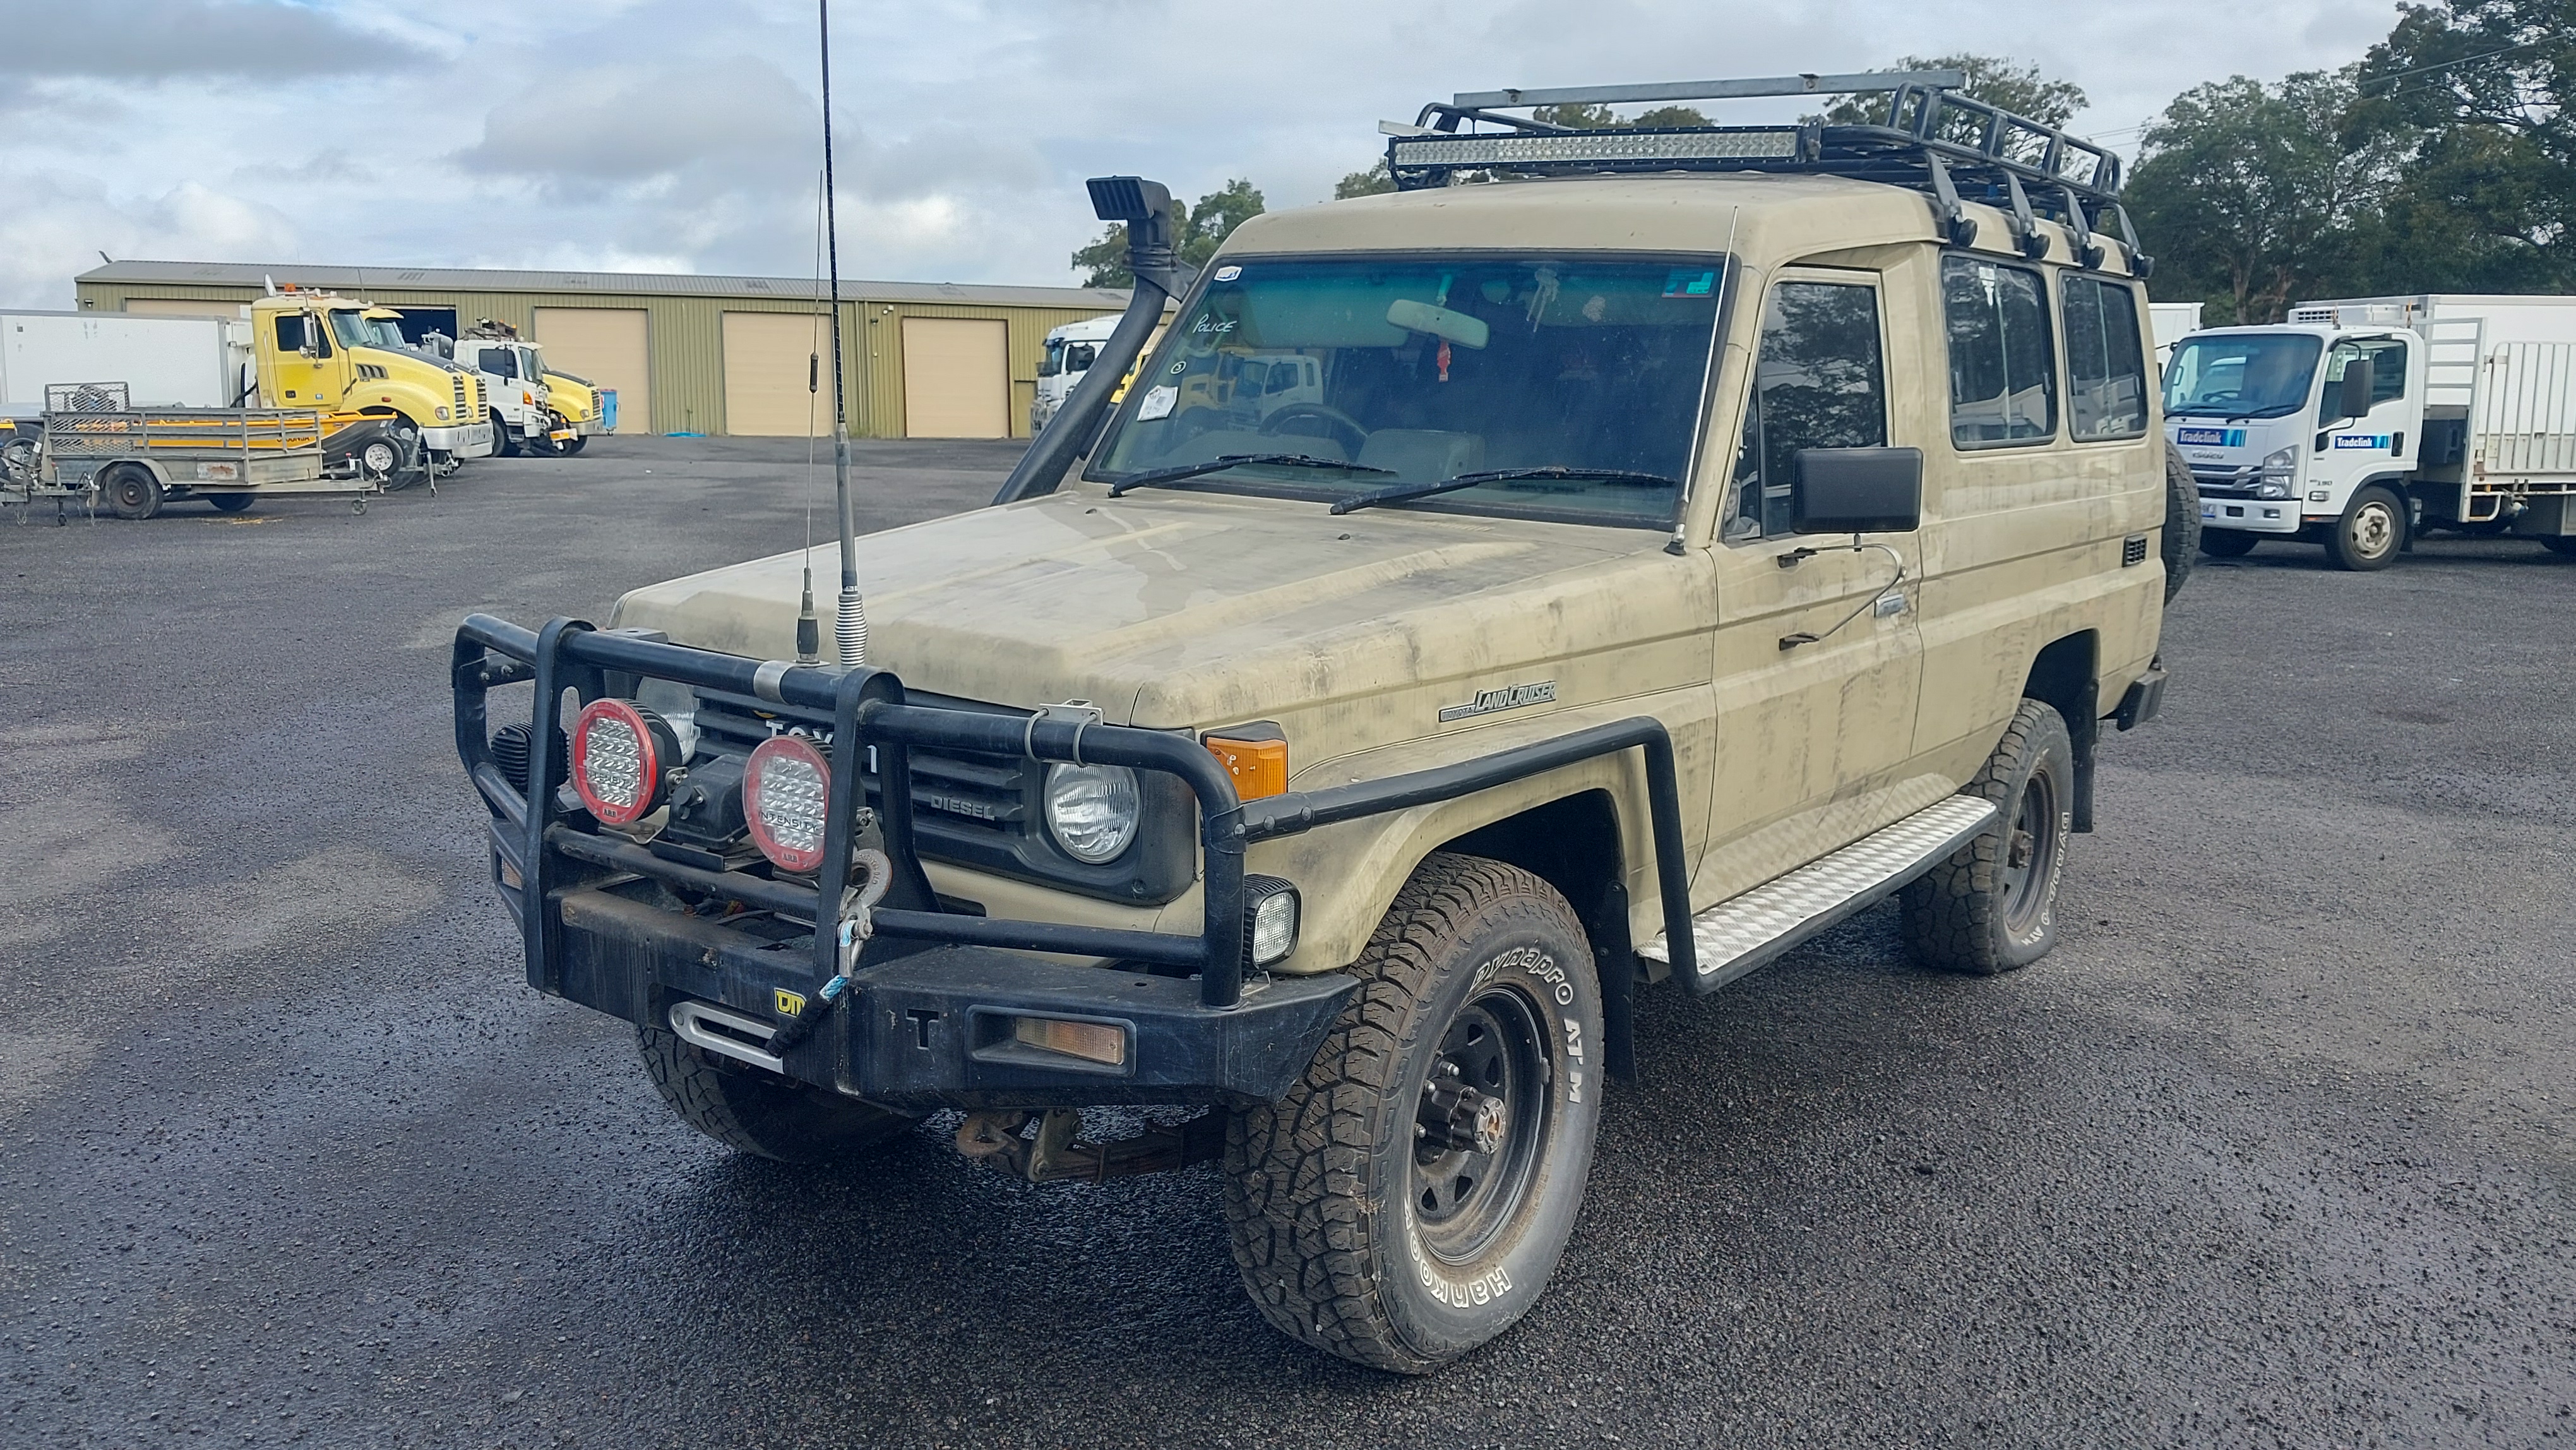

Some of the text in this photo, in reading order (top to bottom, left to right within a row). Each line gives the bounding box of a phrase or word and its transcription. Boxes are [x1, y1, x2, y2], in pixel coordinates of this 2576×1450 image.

[2180, 430, 2222, 443] Tradelink
[2337, 437, 2373, 447] Tradelink
[604, 808, 617, 818] ARB
[931, 794, 995, 821] DIESEL
[758, 810, 817, 832] INTENSITY
[782, 853, 798, 863] ARB
[1468, 946, 1573, 1005] Dynapro
